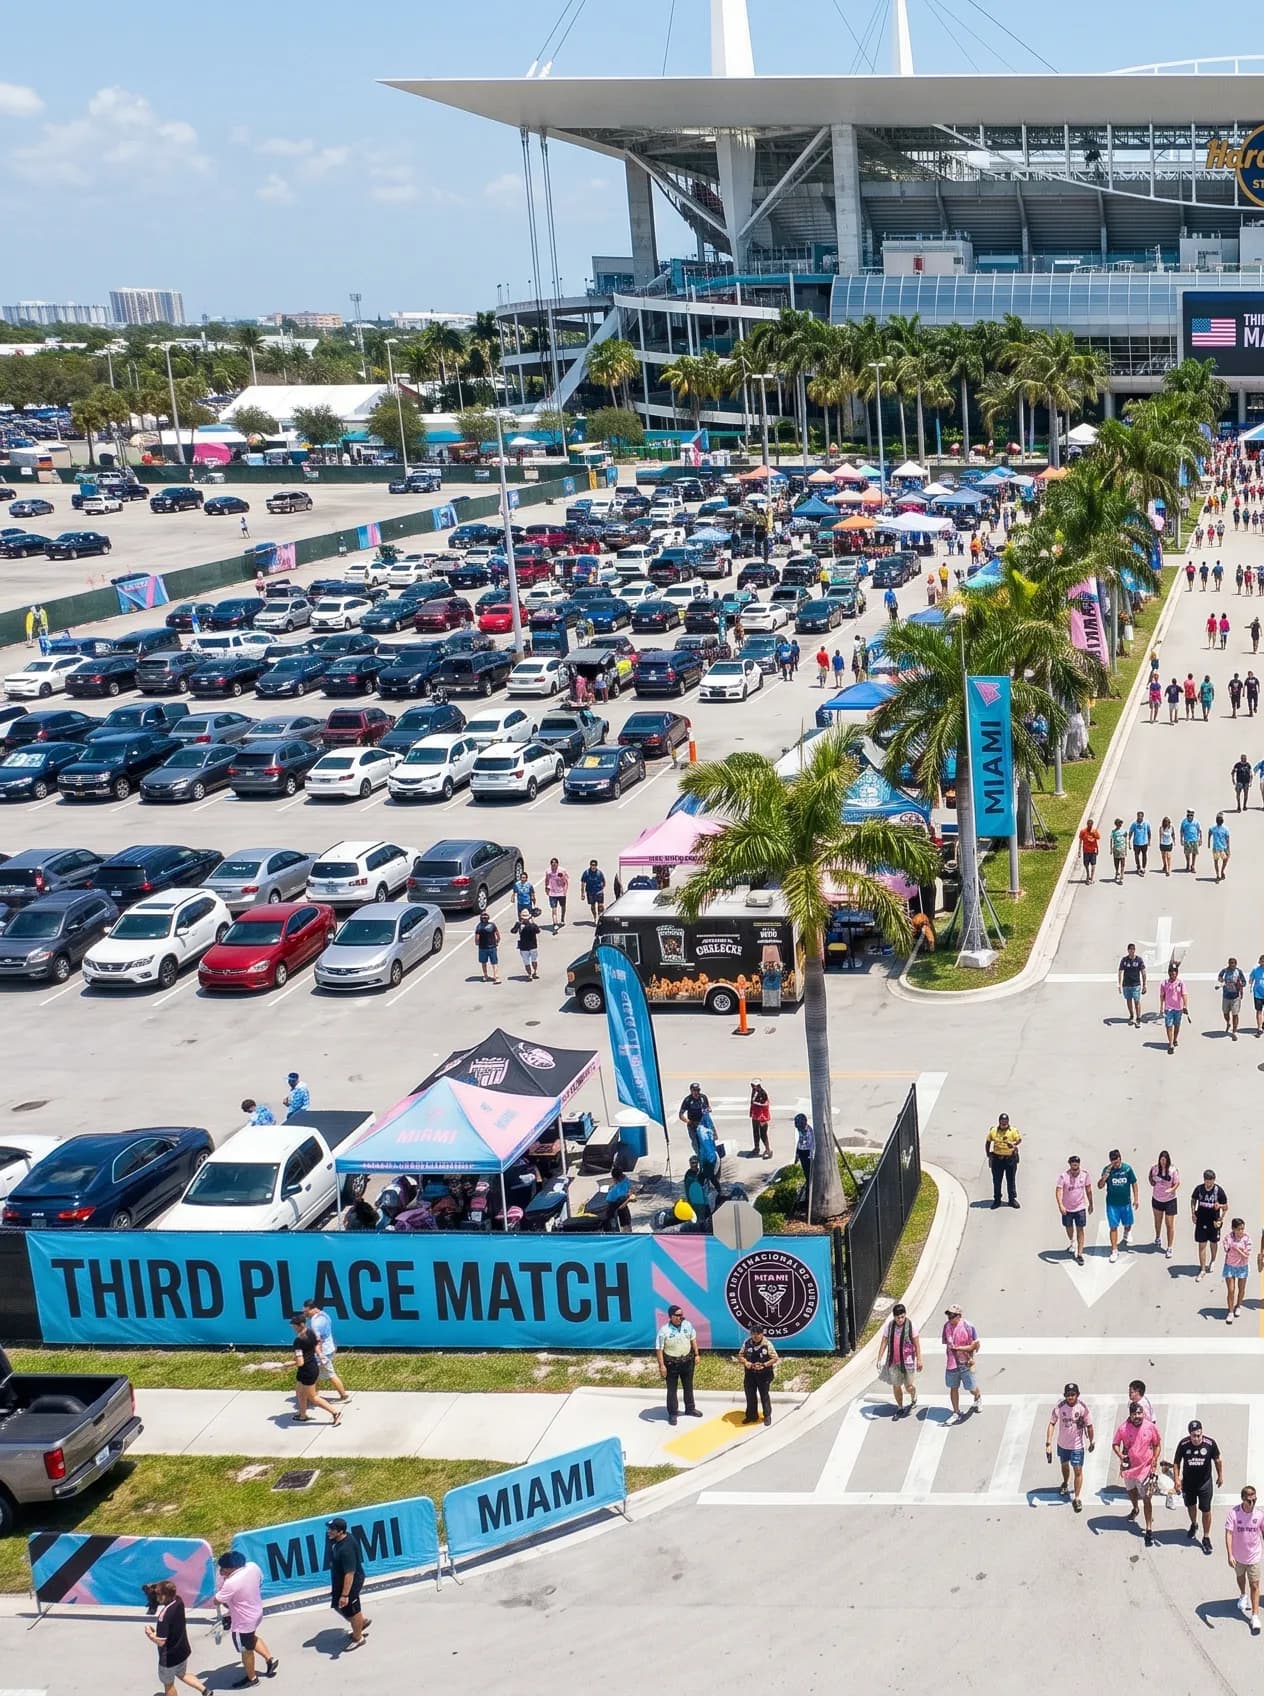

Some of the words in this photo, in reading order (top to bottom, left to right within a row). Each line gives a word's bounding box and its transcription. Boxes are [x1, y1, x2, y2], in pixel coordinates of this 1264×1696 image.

[980, 720, 1005, 814] MIAMI
[396, 1128, 458, 1144] MIAMI
[51, 1258, 224, 1319] THIRD
[239, 1260, 420, 1321] PLACE
[433, 1261, 632, 1322] MATCH
[754, 1274, 789, 1282] MIAMI
[477, 1459, 596, 1534] MIAMI
